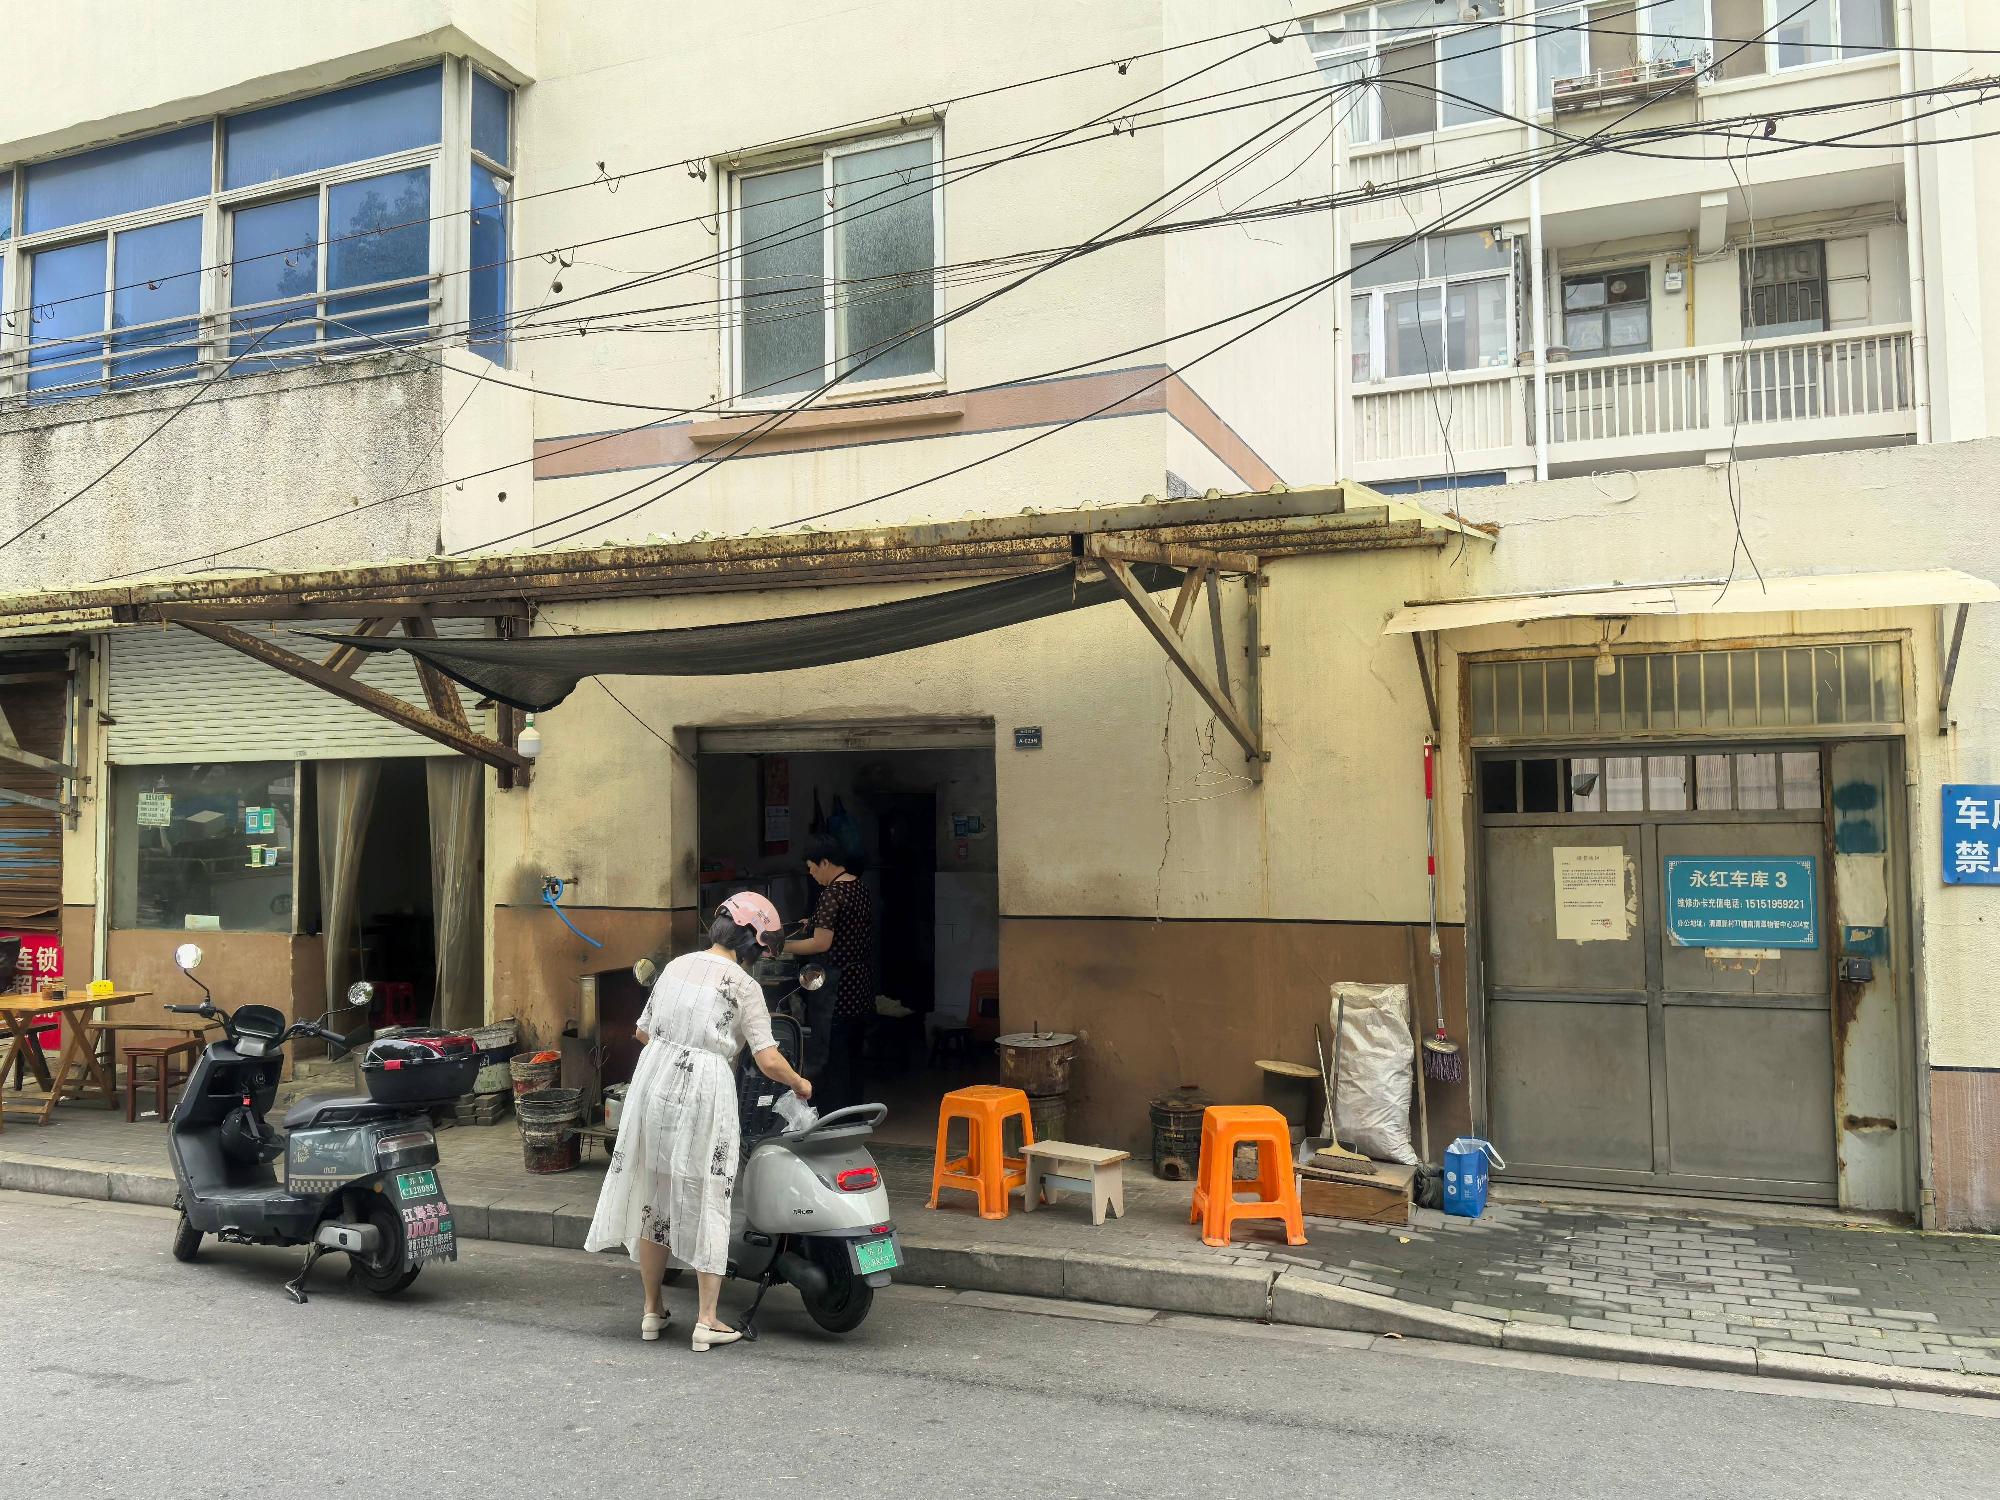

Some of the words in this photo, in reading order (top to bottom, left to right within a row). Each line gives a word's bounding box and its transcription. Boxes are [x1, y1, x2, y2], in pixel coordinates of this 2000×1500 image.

[1955, 796, 2000, 830] 车
[1955, 840, 2000, 873] 禁
[1689, 869, 1769, 888] 永红车库
[1775, 871, 1788, 888] 3
